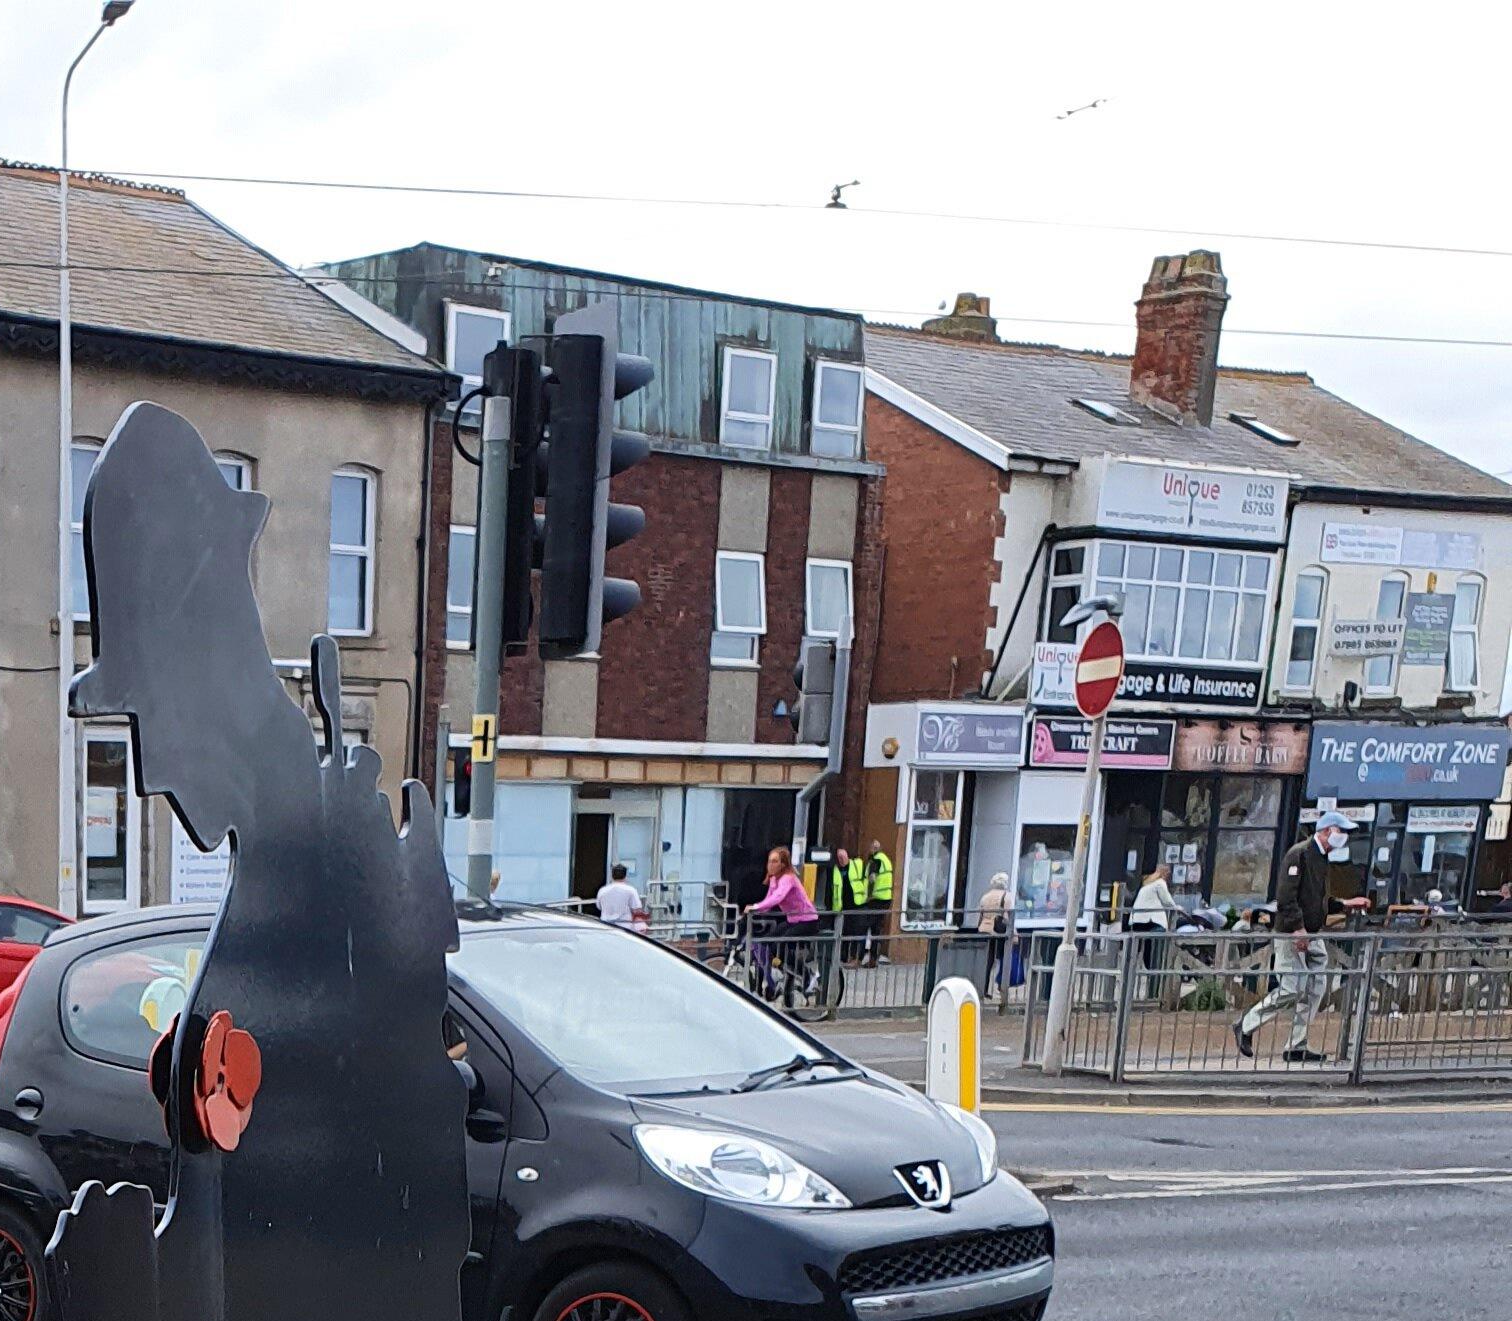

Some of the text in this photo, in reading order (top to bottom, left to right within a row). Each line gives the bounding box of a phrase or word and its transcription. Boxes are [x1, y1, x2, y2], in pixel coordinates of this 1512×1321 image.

[1163, 472, 1221, 506] Unique
[1373, 623, 1386, 634] TO
[1155, 672, 1166, 693] &
[1168, 673, 1191, 692] Life
[1192, 674, 1256, 699] Insurance
[1320, 737, 1500, 764] THE COMFORT ZONE
